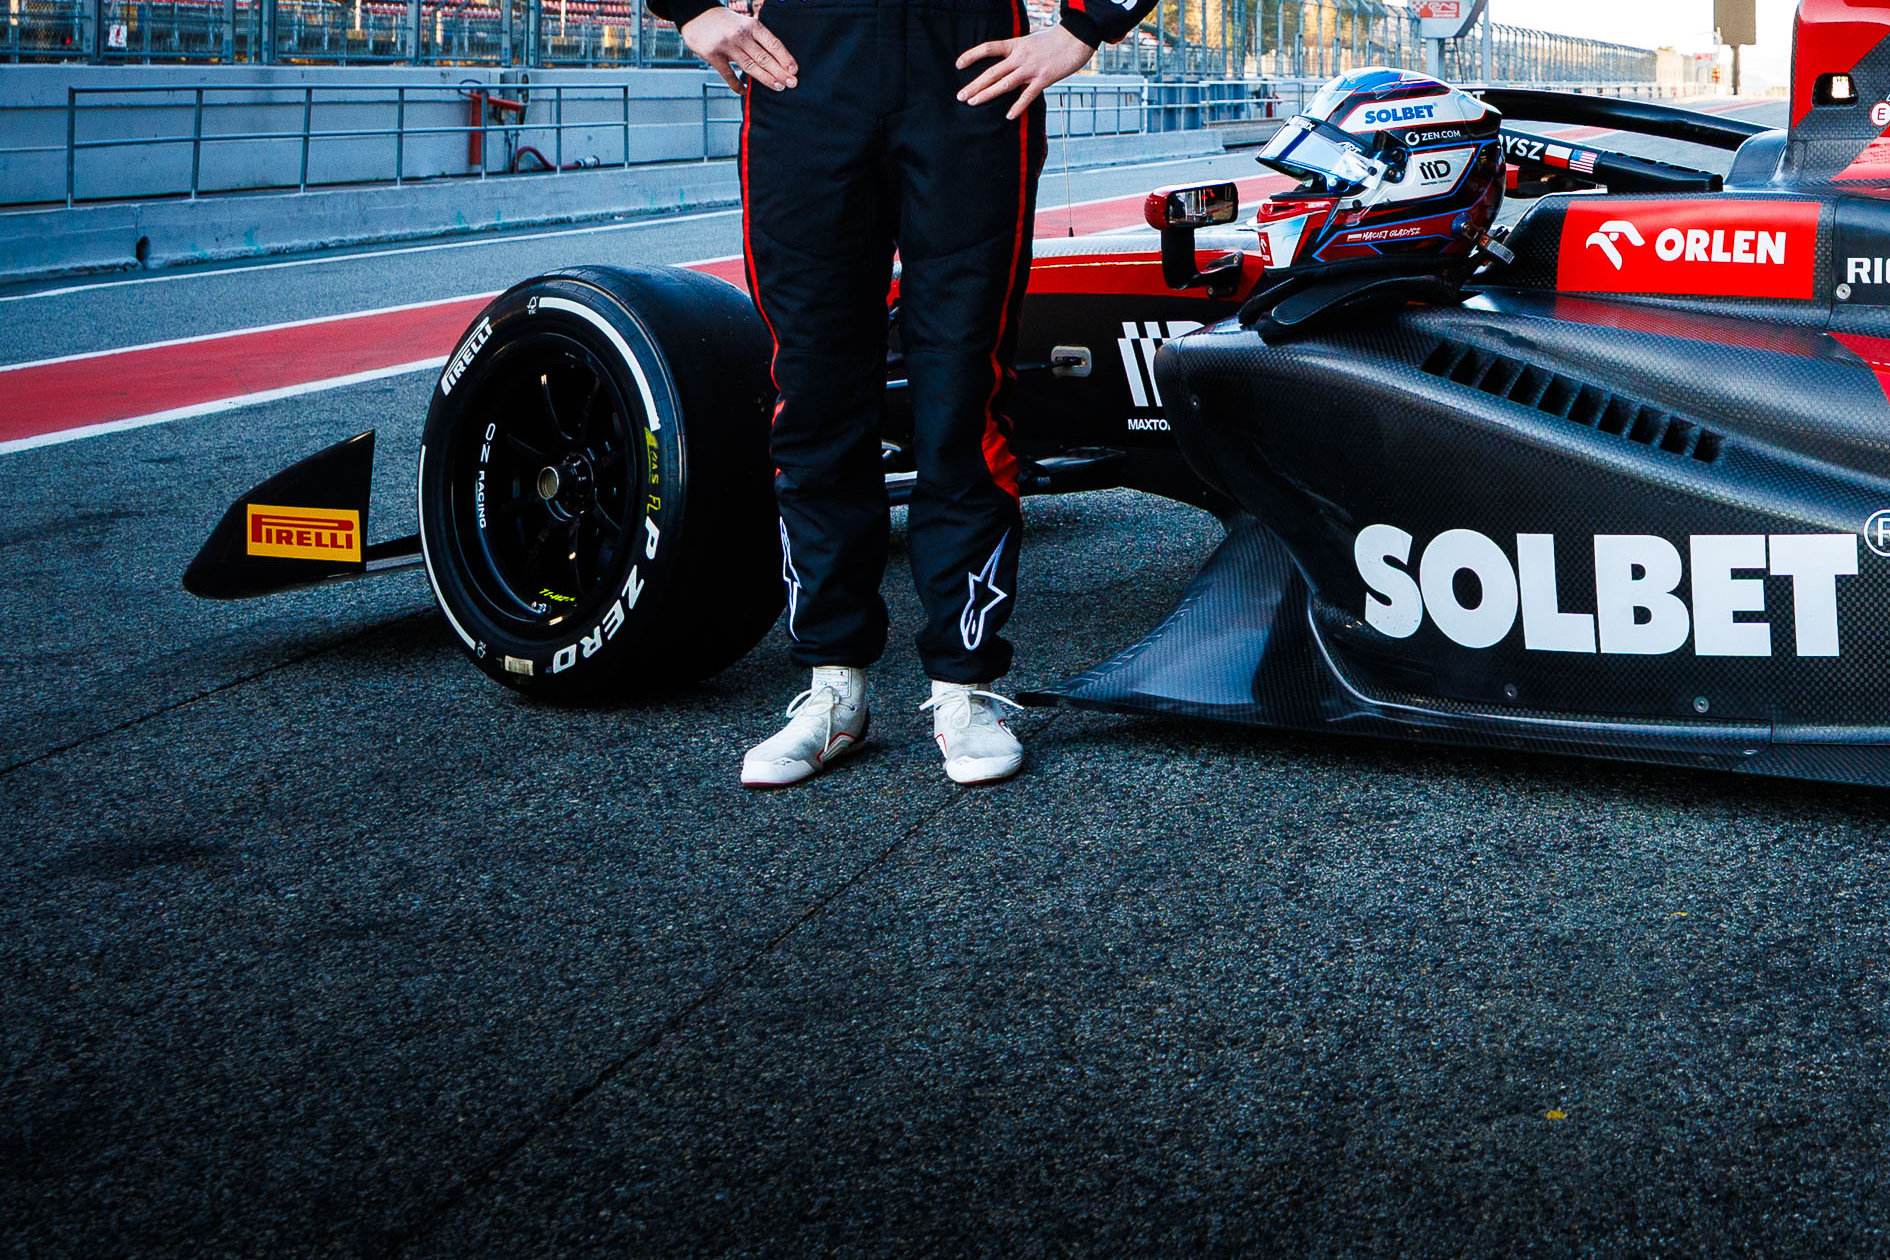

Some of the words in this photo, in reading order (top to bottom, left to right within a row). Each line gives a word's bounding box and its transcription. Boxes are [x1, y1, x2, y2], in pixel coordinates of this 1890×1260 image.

[1364, 103, 1435, 125] SOLBET
[1876, 107, 1887, 121] E
[1421, 128, 1462, 142] ZEN.COM
[1361, 229, 1389, 242] MACIEJ
[1654, 226, 1786, 266] ORLEN
[441, 316, 493, 397] PIRELLI
[477, 470, 488, 530] RACING
[251, 514, 354, 550] PIRELLI
[642, 515, 661, 562] P
[1355, 522, 1859, 658] SOLBET
[552, 563, 646, 675] ZERO
